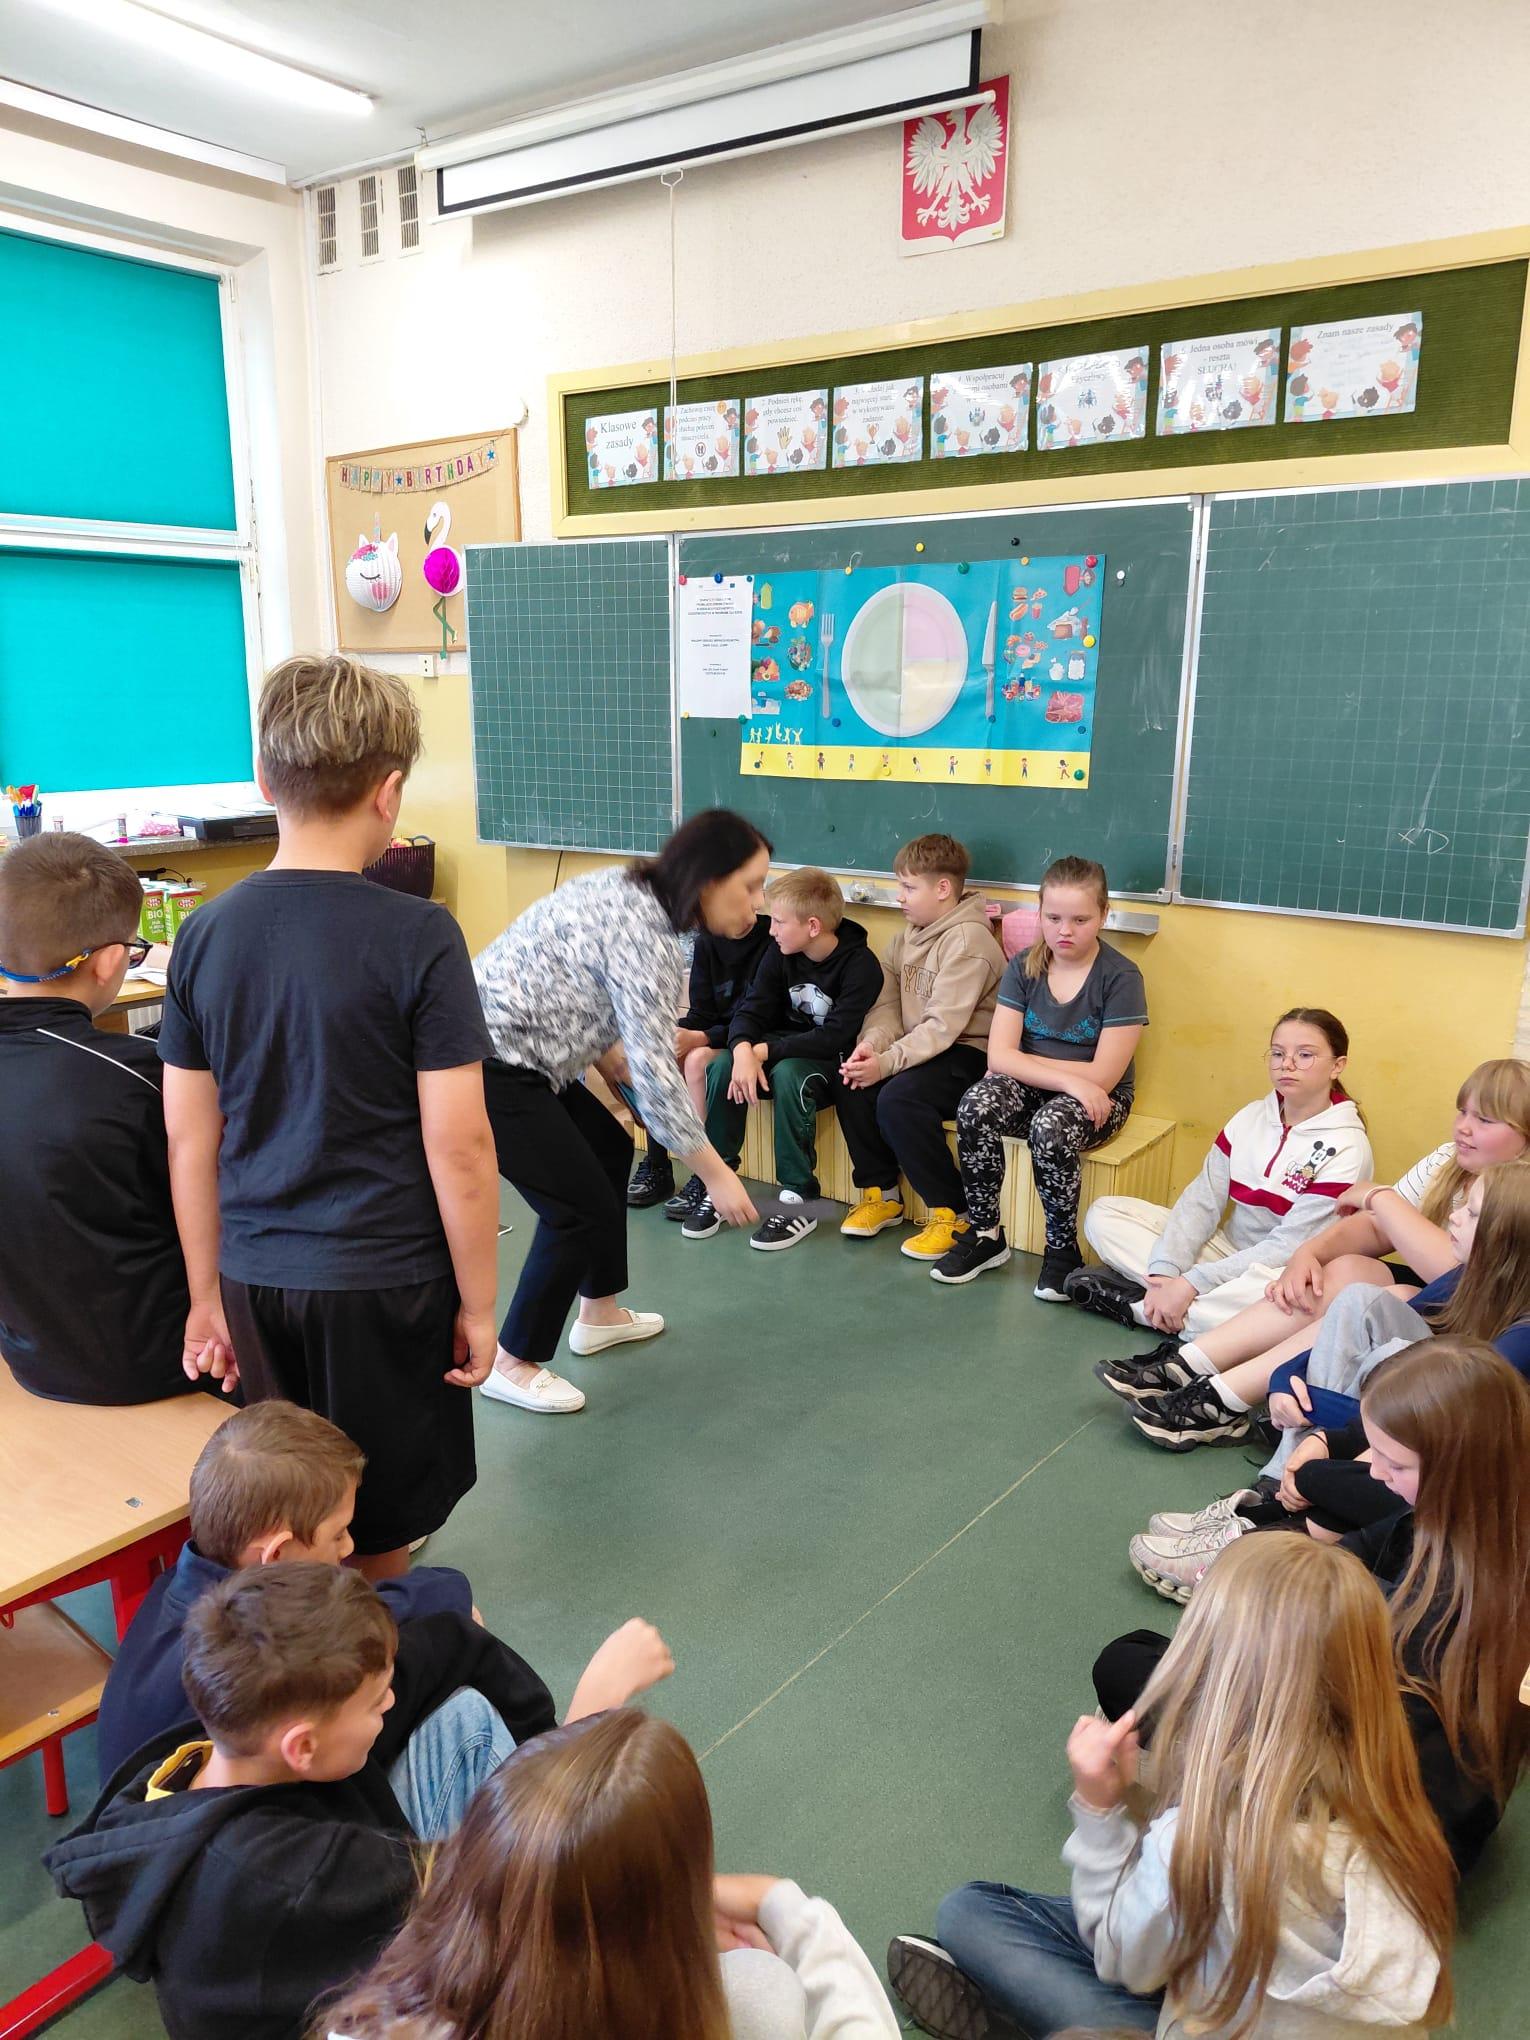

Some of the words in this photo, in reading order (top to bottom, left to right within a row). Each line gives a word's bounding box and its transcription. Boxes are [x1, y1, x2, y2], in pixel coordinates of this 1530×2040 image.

[1317, 330, 1340, 339] Znam
[1366, 322, 1393, 333] zasady
[600, 420, 637, 434] Klasowe
[606, 435, 634, 449] zasady
[341, 467, 391, 485] HAPPY
[406, 451, 483, 487] BIRTHDAY
[147, 909, 163, 920] BIO
